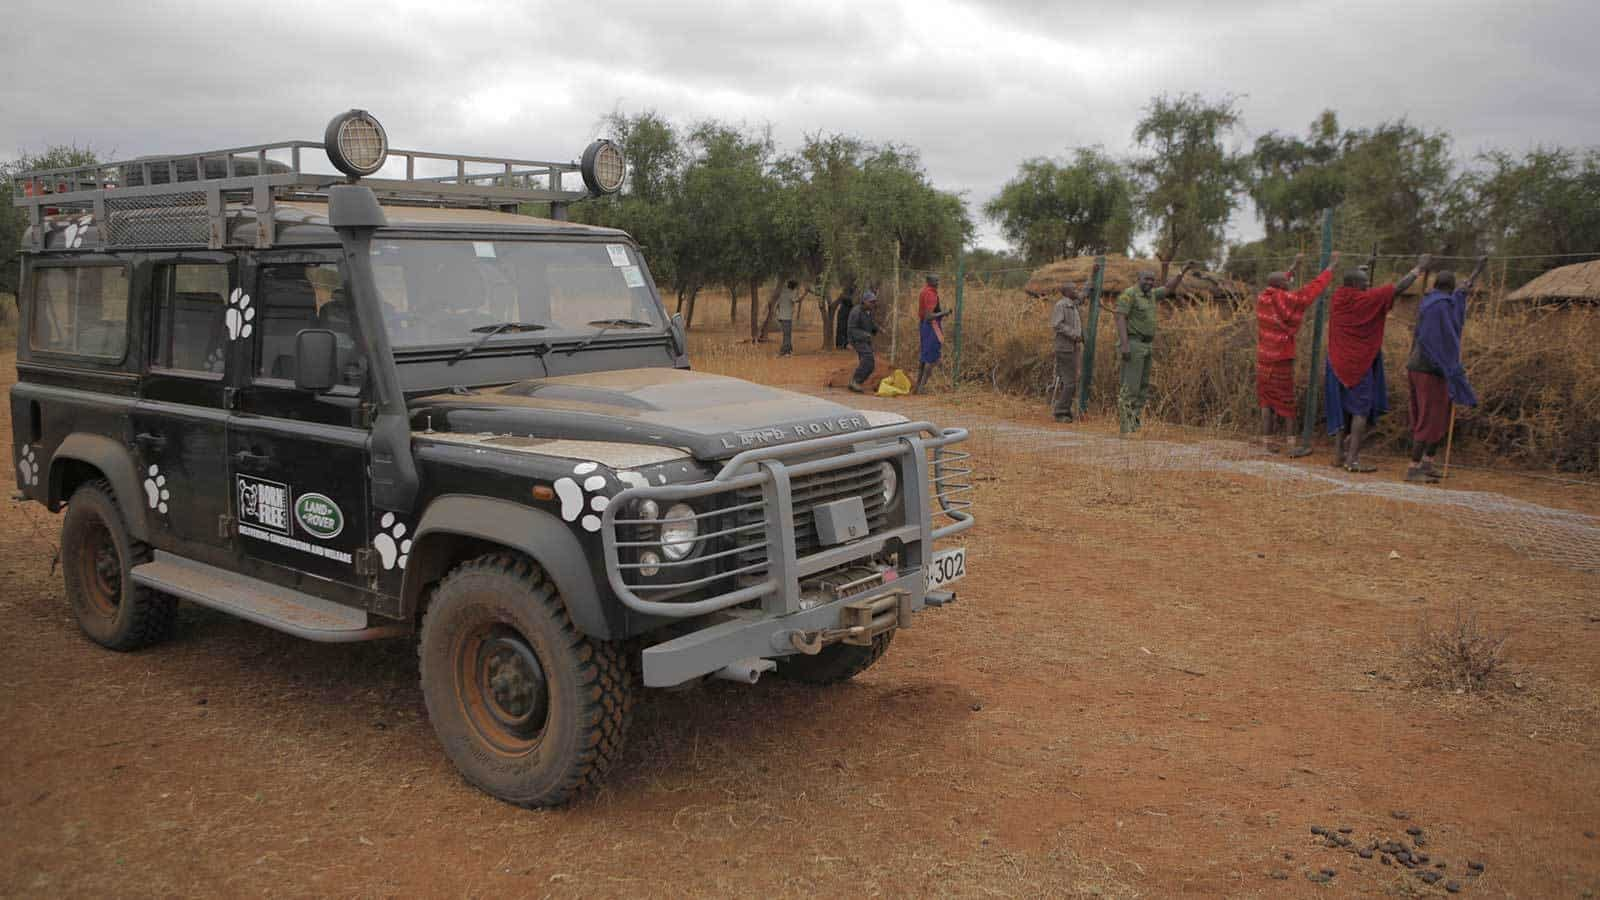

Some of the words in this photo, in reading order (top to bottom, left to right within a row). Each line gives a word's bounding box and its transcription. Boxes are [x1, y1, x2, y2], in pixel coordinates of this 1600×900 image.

[720, 428, 784, 449] LAND
[793, 417, 861, 437] ROVER
[258, 483, 283, 508] BORN
[259, 503, 285, 529] FREE
